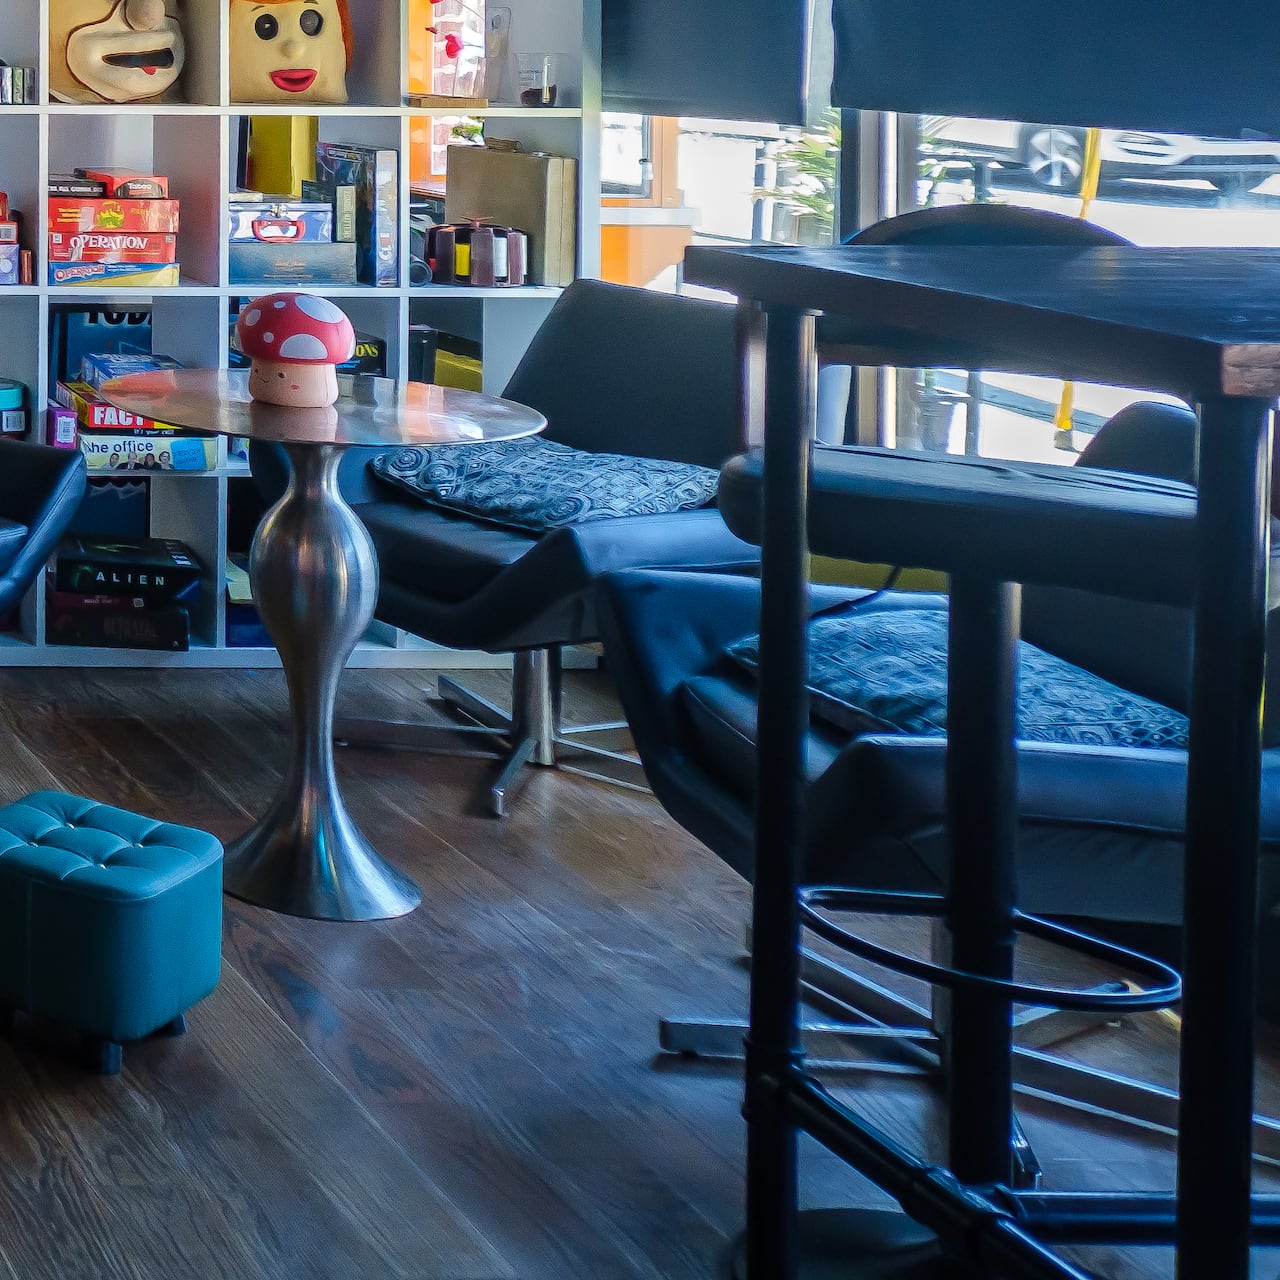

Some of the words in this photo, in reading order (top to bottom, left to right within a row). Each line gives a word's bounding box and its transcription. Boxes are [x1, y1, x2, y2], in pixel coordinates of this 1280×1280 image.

[70, 234, 148, 250] OPERATION
[113, 440, 154, 453] office
[96, 571, 166, 586] ALIEN
